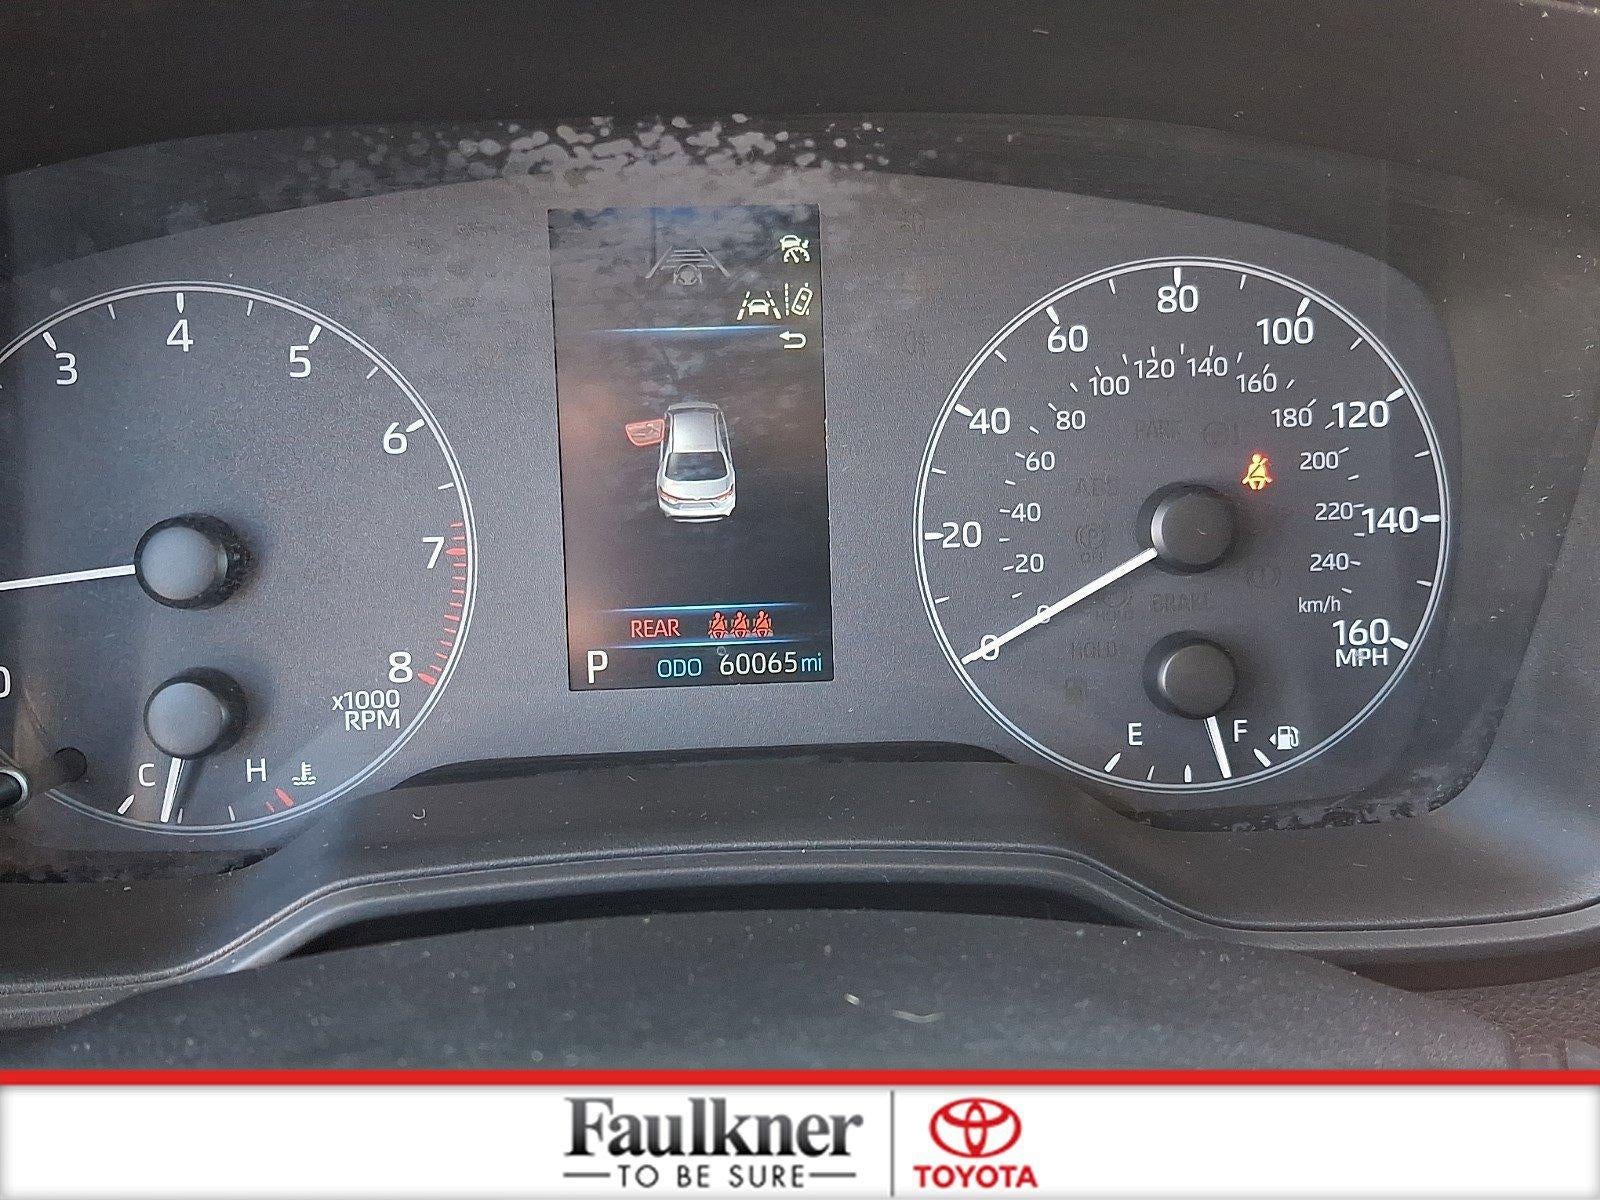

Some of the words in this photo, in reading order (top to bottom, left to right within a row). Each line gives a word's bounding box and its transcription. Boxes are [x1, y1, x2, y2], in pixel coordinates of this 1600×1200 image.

[1157, 285, 1199, 313] 80
[166, 320, 194, 352] 4
[1047, 325, 1088, 353] 60
[1256, 317, 1314, 345] 100
[55, 352, 79, 386] 3
[289, 345, 312, 378] 5
[1133, 359, 1175, 379] 120
[1186, 356, 1228, 377] 140
[1088, 376, 1130, 396] 100
[1236, 373, 1277, 393] 160
[968, 407, 1011, 435] 40
[1056, 410, 1086, 430] 80
[1271, 407, 1312, 428] 180
[1331, 401, 1390, 428] 120
[382, 422, 408, 454] 6
[1025, 451, 1056, 471] 60
[1300, 451, 1339, 470] 200
[1011, 503, 1042, 522] 40
[1315, 502, 1354, 521] 220
[1361, 506, 1419, 534] 140
[942, 521, 982, 549] 20
[422, 536, 446, 569] 7
[1015, 554, 1045, 573] 20
[1310, 553, 1349, 571] 240
[1298, 595, 1341, 614] km/h
[630, 618, 681, 638] REAR
[1332, 618, 1389, 646] 160
[980, 634, 1000, 661] 0
[1335, 647, 1389, 668] MPH
[388, 651, 414, 683] 8
[587, 650, 609, 684] P
[657, 657, 703, 679] ODO
[719, 651, 798, 676] 60065
[801, 652, 823, 672] mi
[331, 690, 401, 711] x1000
[344, 709, 401, 731] RPM
[1233, 719, 1248, 742] F
[1128, 722, 1143, 746] E
[138, 763, 156, 787] C
[246, 759, 268, 783] H
